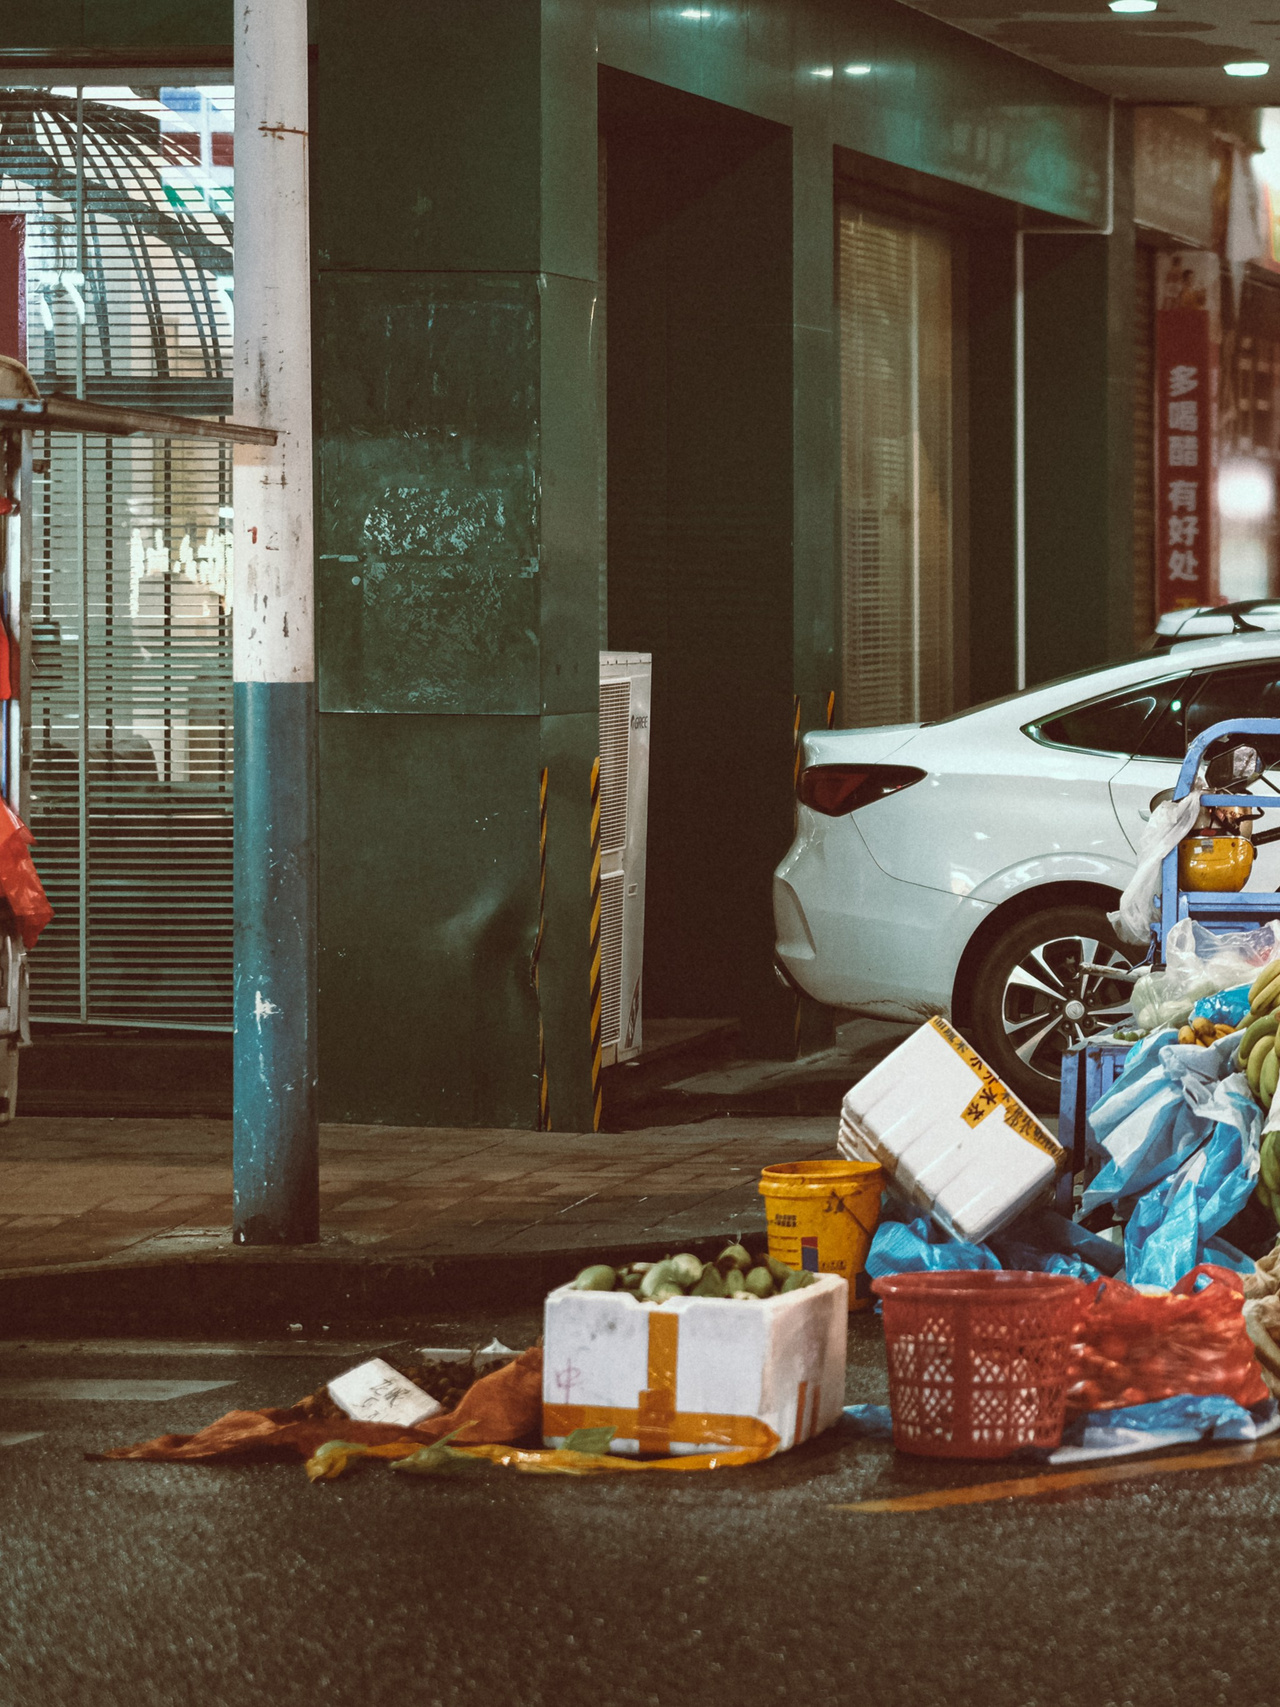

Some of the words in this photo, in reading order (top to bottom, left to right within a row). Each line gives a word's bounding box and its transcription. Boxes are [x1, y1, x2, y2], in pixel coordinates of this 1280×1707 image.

[1168, 480, 1199, 581] 有好处
[635, 715, 649, 729] GREE
